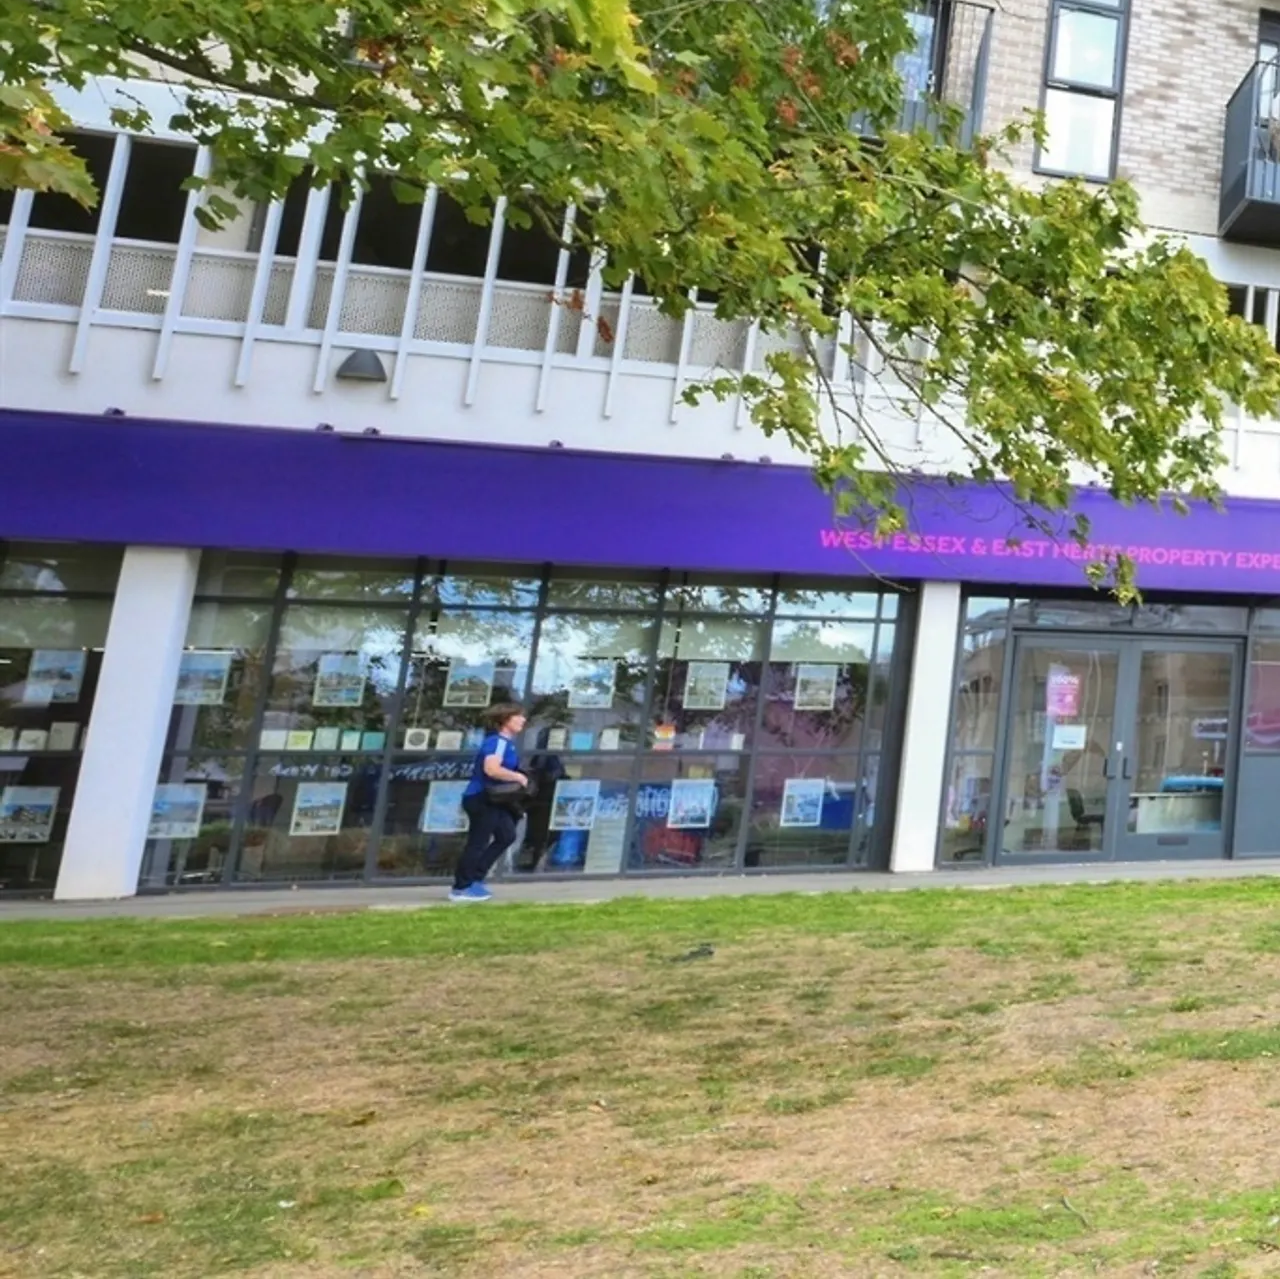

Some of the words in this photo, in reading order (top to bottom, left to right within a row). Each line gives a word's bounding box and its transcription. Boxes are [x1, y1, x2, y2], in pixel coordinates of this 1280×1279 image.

[892, 533, 966, 554] ESSEX
[970, 537, 987, 556] &
[1126, 545, 1232, 567] PROPERTY
